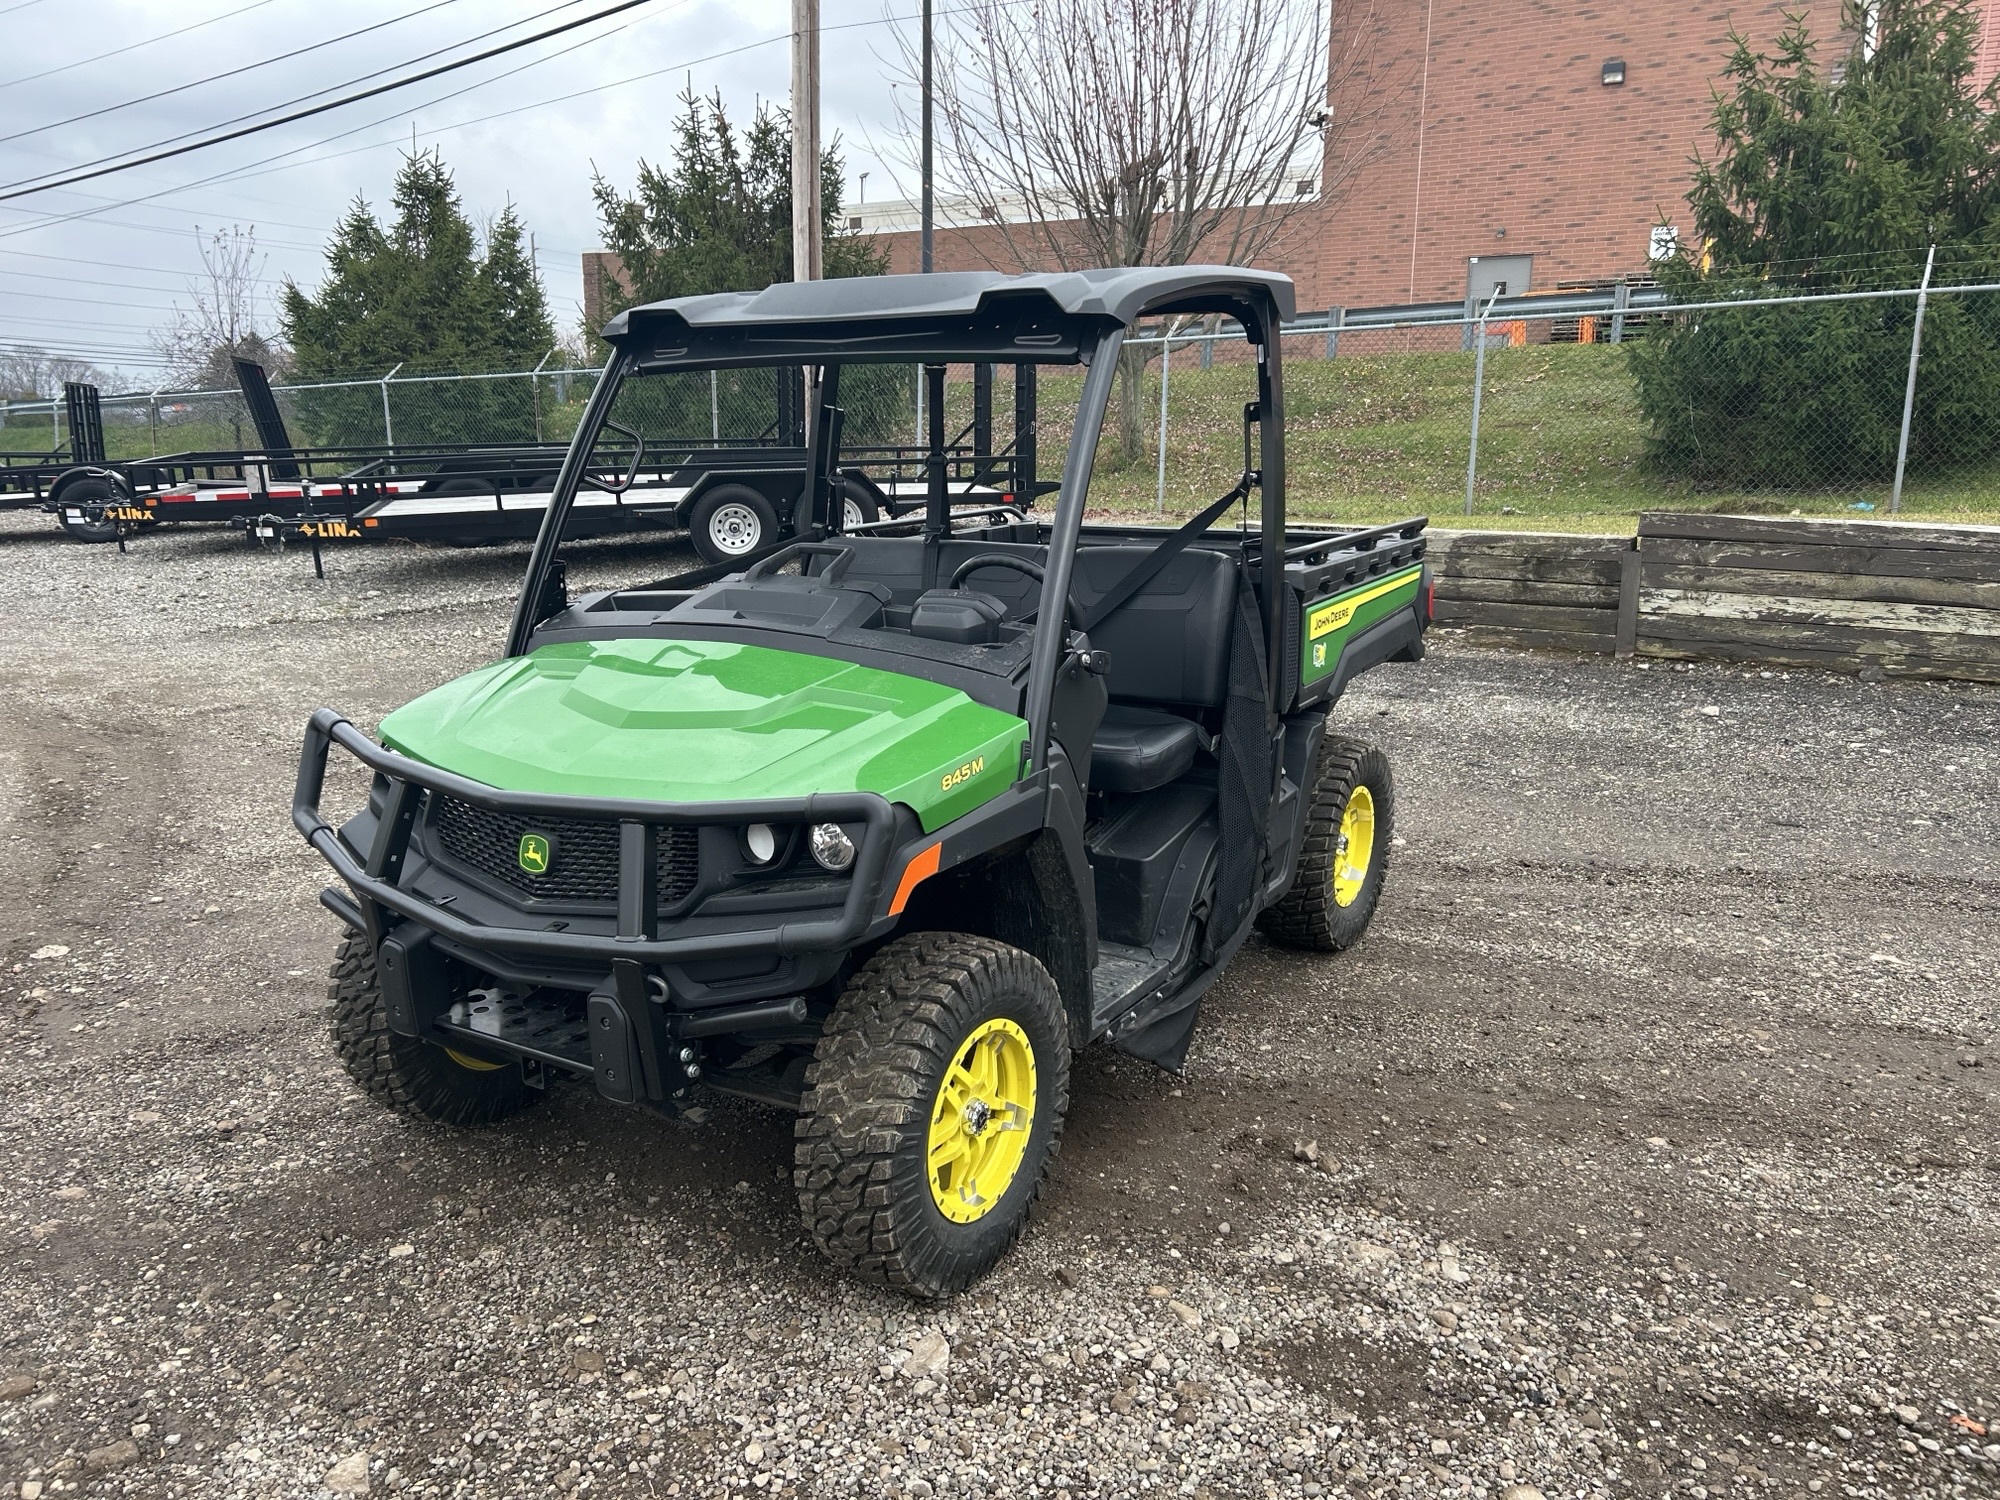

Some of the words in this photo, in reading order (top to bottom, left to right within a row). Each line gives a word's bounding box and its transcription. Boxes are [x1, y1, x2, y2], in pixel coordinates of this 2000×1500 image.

[117, 507, 155, 520] LINX
[1314, 615, 1331, 631] JOHN
[1330, 607, 1350, 624] DEERE
[940, 754, 984, 793] 845M
